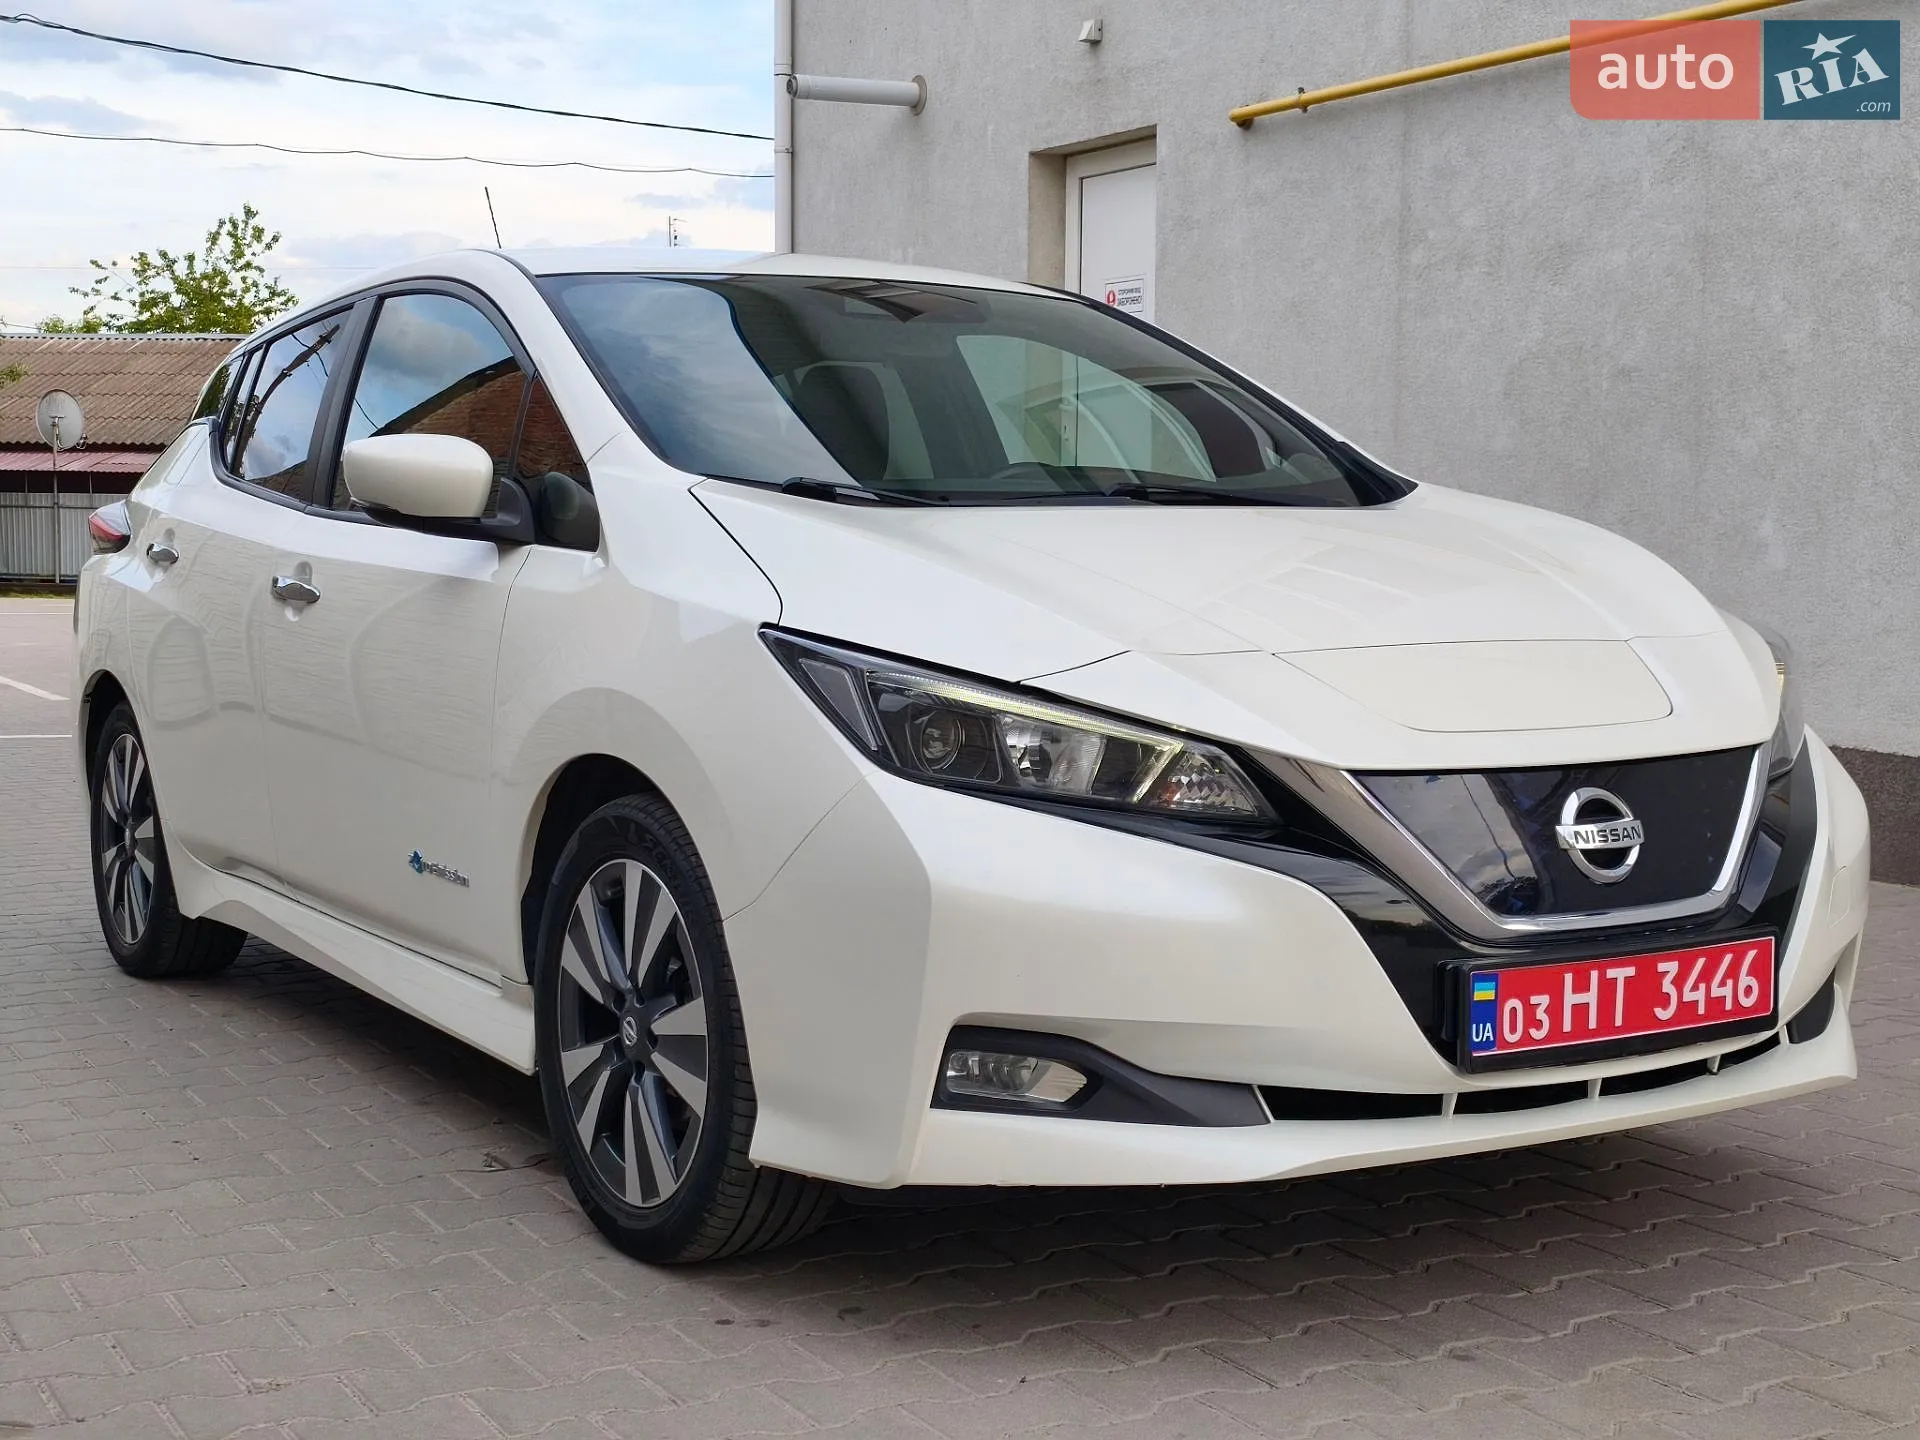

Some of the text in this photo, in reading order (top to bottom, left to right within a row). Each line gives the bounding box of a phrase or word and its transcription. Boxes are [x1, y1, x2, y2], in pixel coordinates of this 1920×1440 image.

[1573, 824, 1641, 845] NISSAN
[1502, 949, 1760, 1043] 03 HT 3446
[1472, 1022, 1494, 1043] UA
